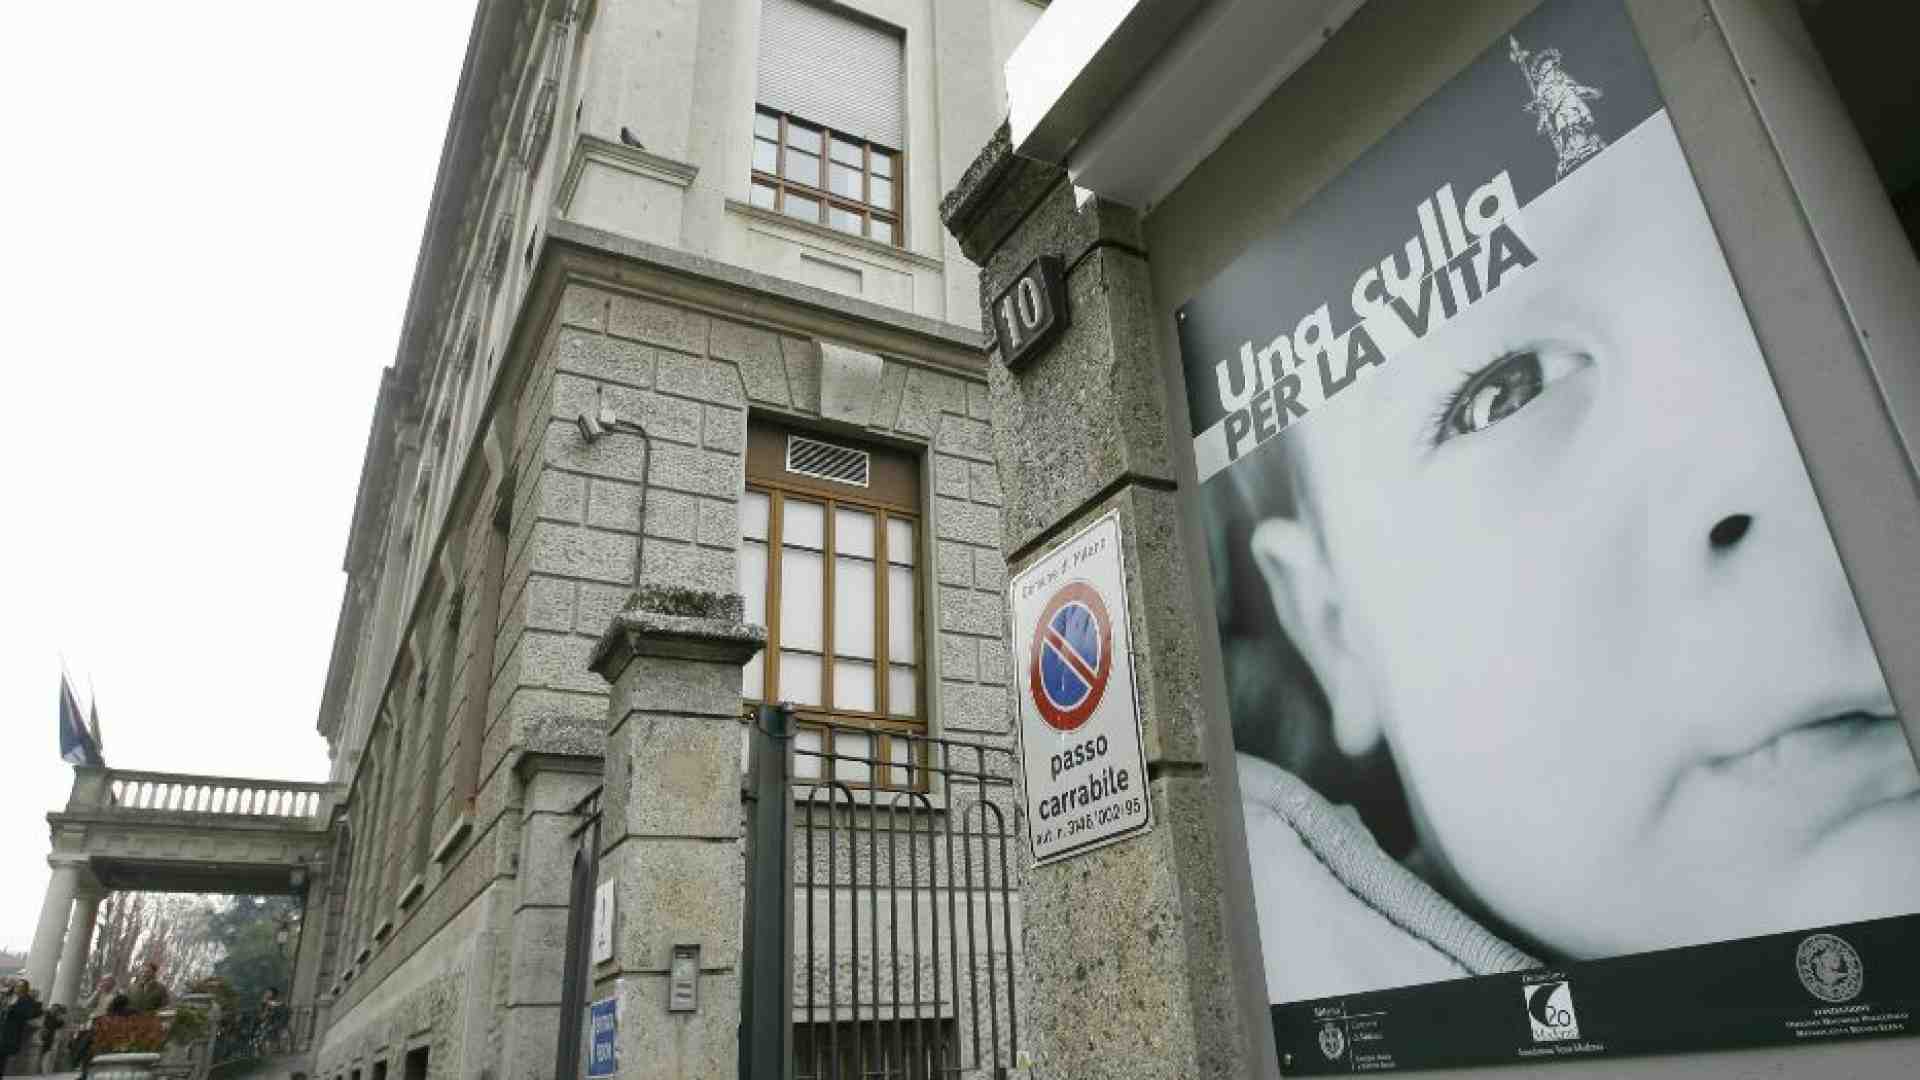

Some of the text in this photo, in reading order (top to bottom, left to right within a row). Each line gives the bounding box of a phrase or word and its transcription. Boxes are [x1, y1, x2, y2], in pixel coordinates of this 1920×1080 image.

[1001, 276, 1041, 349] 10
[1215, 169, 1521, 413] Una culla
[1224, 223, 1539, 461] PER LA VITA
[1038, 766, 1129, 821] carrabile
[1051, 734, 1109, 782] passo
